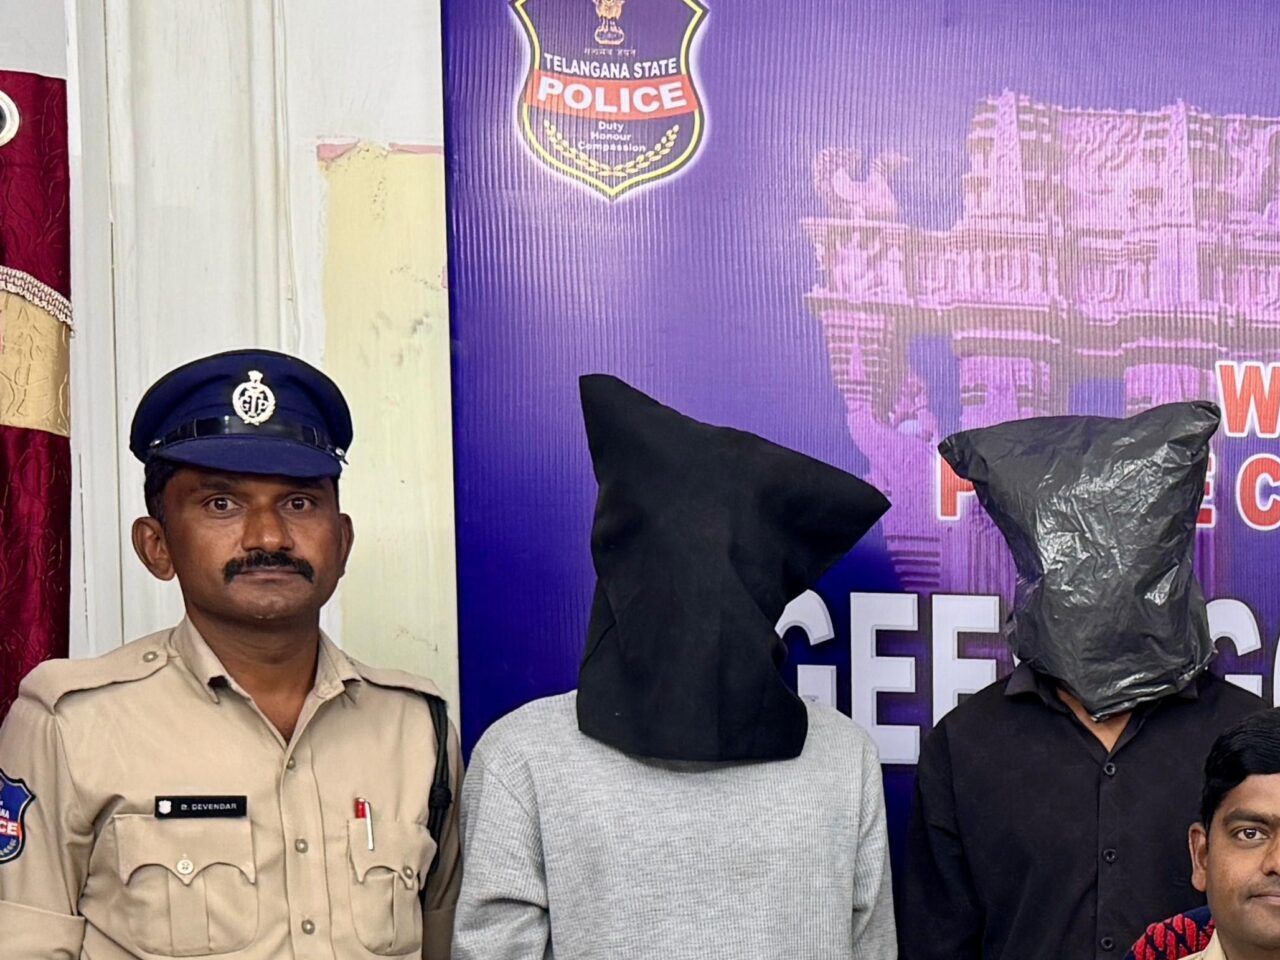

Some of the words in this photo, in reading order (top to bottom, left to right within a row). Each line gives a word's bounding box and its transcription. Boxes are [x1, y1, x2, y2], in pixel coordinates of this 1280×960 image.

[543, 53, 630, 78] TELANGANA
[634, 57, 678, 78] STATE
[537, 76, 687, 113] POLICE
[598, 121, 624, 133] Duty
[590, 132, 632, 142] Honour
[577, 141, 647, 153] Compassion
